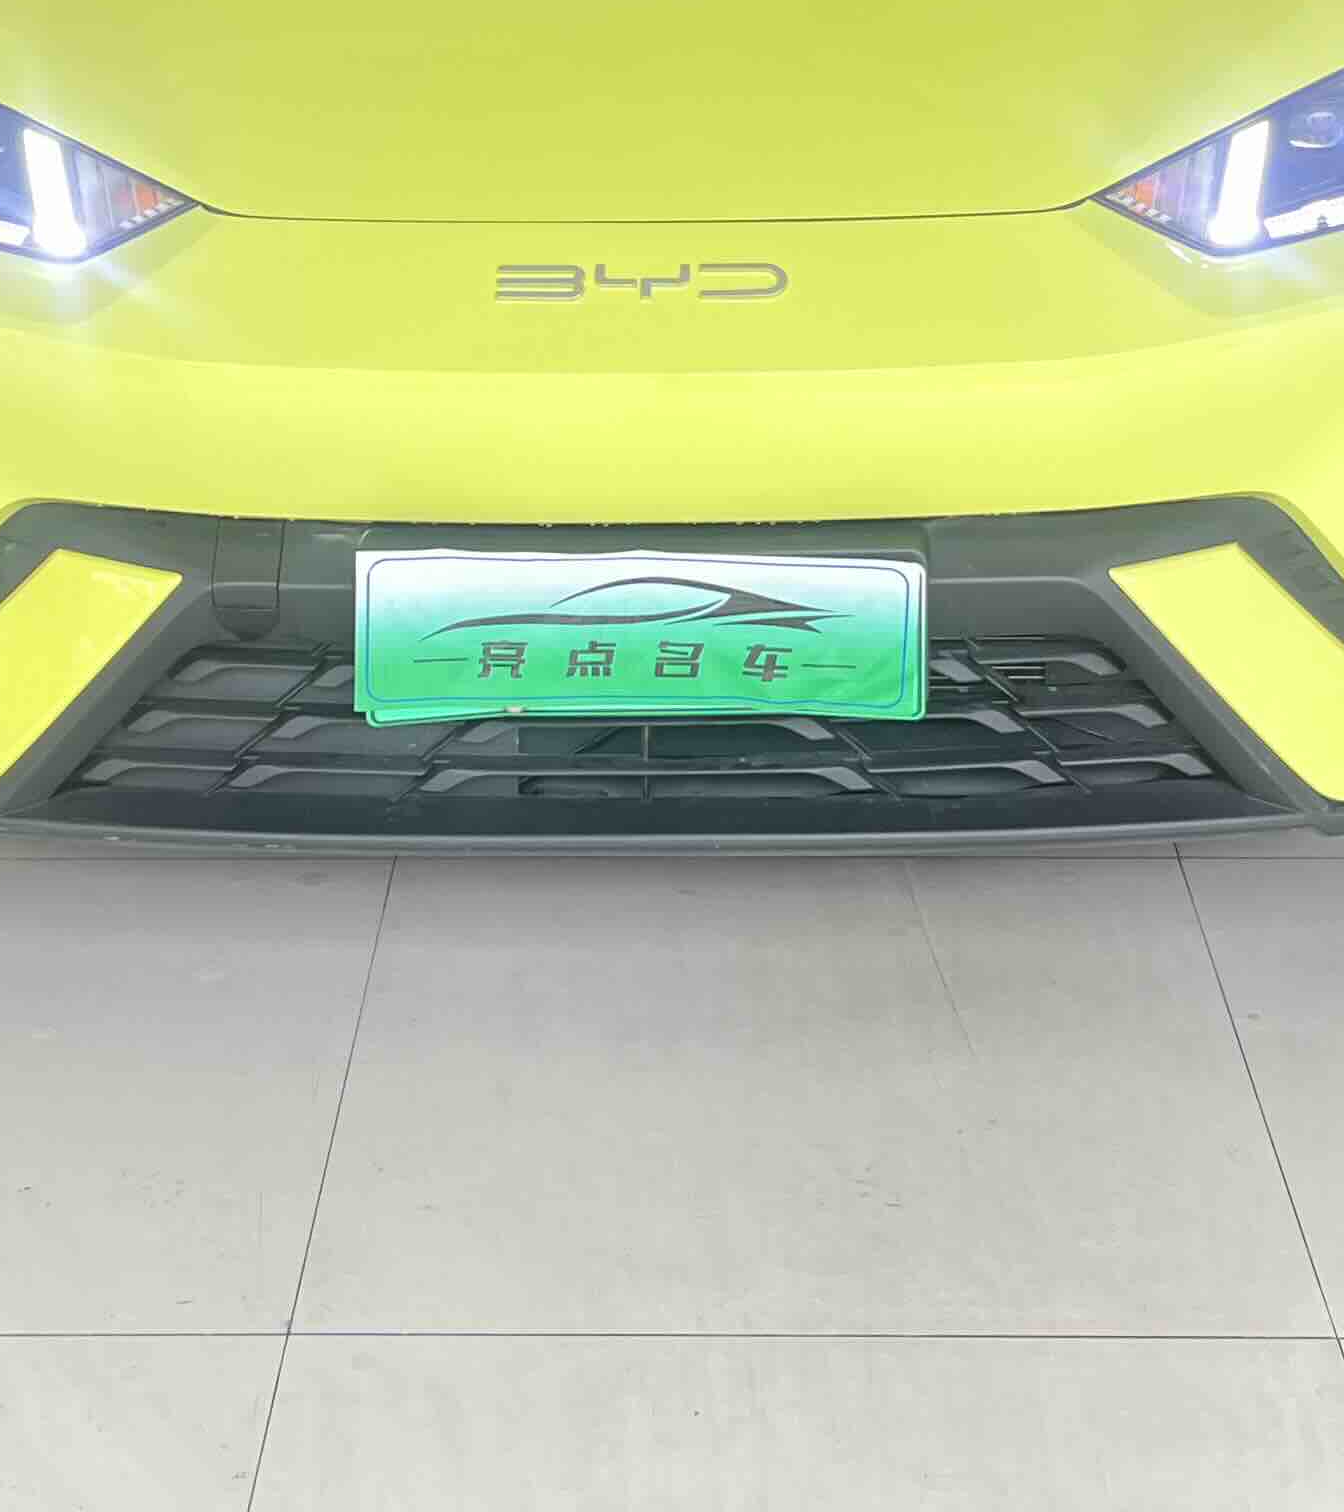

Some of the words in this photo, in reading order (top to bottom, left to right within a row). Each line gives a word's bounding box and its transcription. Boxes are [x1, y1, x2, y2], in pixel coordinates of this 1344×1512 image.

[494, 263, 789, 301] BYD
[477, 639, 793, 683] 亮点名车
